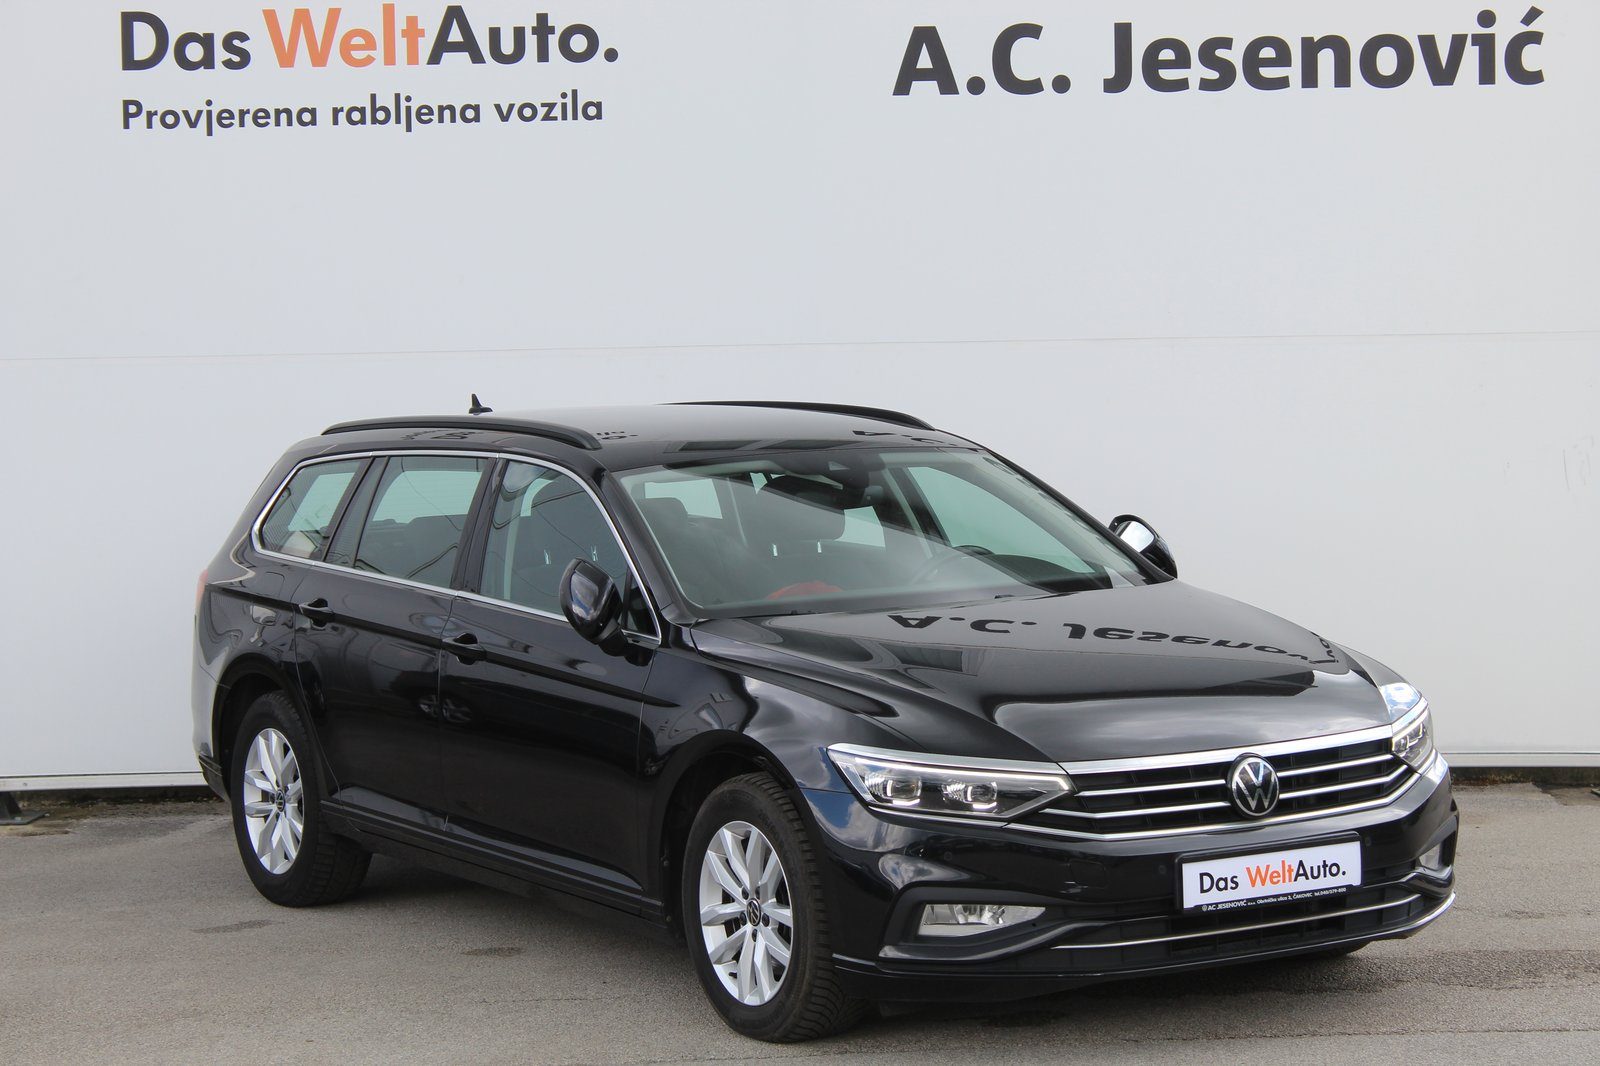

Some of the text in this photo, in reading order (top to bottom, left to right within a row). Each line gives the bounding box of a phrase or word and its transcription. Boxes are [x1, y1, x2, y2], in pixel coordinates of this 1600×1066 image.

[121, 4, 618, 71] Das WeltAuto.
[893, 6, 1544, 96] A.C. Jesenović
[123, 89, 602, 136] Provjerena rabljena vozila
[1199, 859, 1347, 893] Das WeltAuto.
[1217, 899, 1247, 910] JESENOVIĆ
